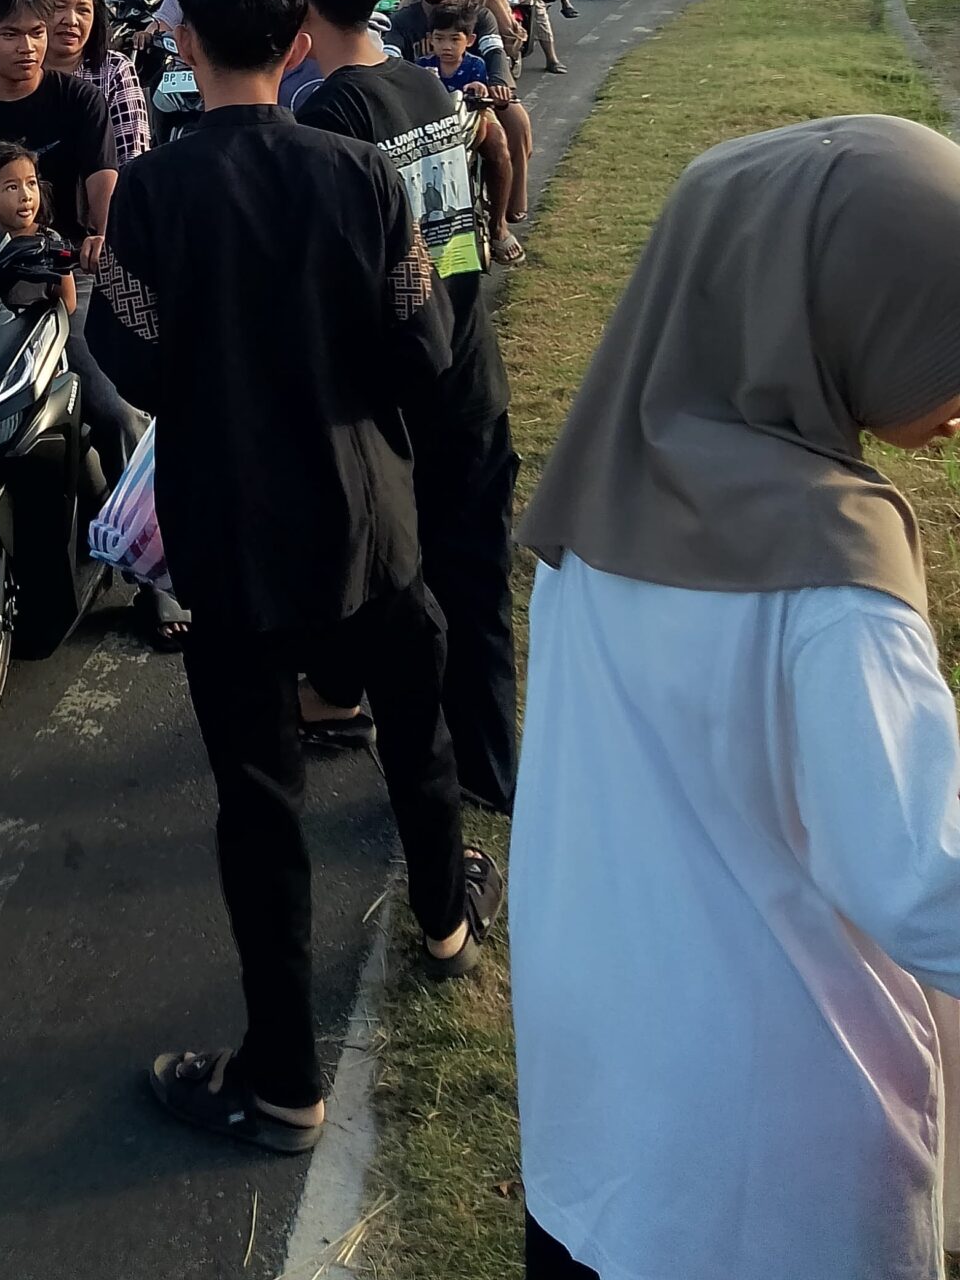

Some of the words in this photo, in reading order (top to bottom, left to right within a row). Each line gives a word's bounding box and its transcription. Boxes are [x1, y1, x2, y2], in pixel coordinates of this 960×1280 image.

[164, 73, 177, 82] BP
[181, 72, 193, 81] 36
[376, 127, 425, 151] ALUMNI
[424, 114, 460, 134] SMPI
[416, 135, 433, 146] AL
